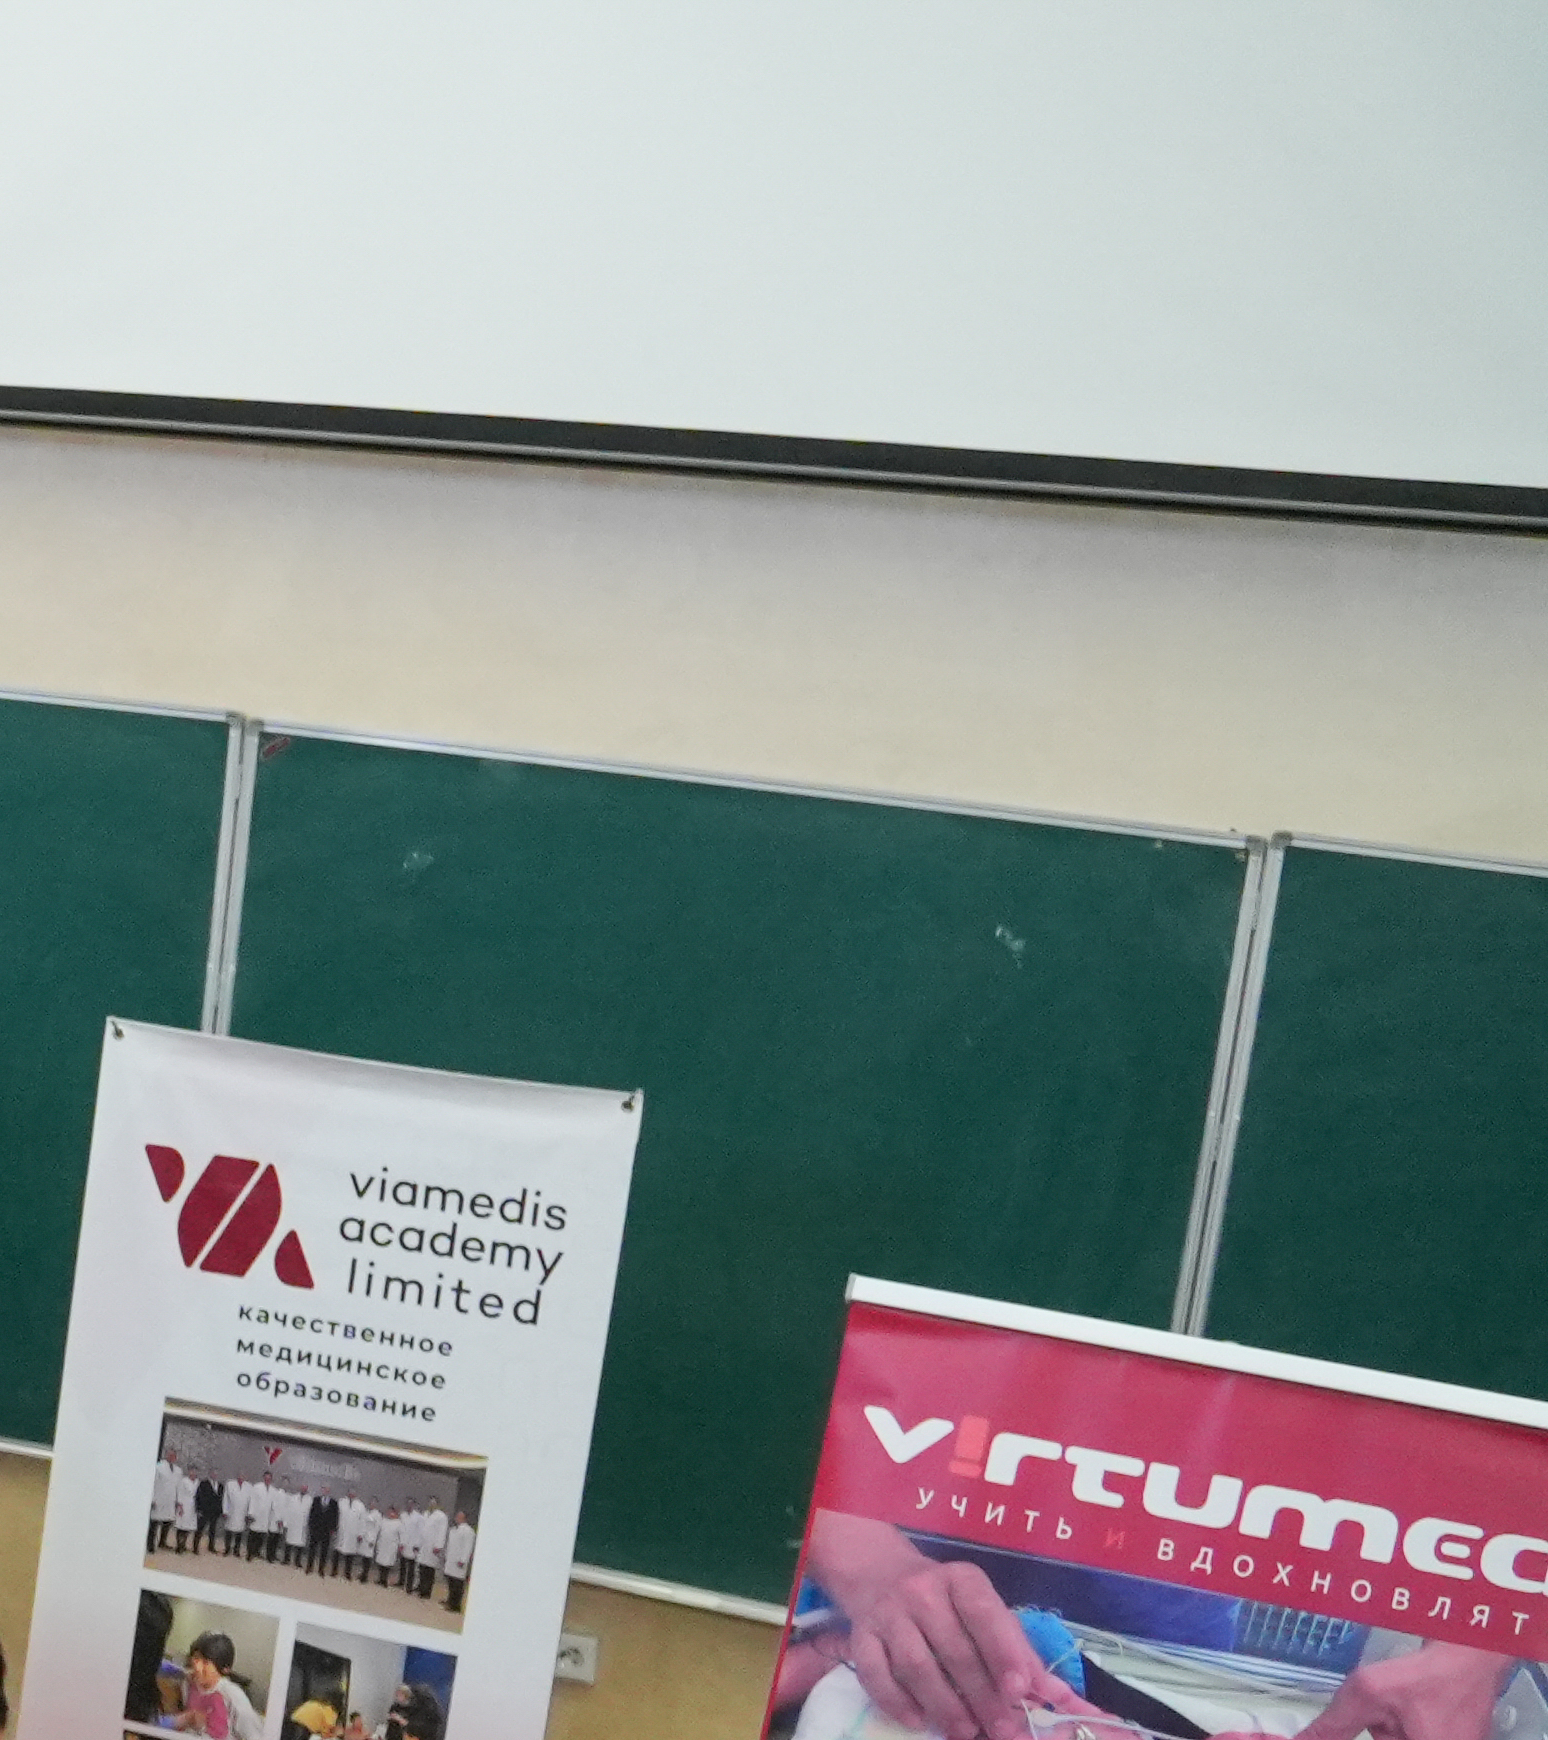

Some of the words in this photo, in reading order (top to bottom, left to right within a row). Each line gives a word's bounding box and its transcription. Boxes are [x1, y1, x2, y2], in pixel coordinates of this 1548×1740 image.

[349, 1166, 568, 1232] viamedis
[339, 1214, 564, 1284] academy
[347, 1258, 542, 1326] limited
[239, 1303, 454, 1358] качественное
[236, 1337, 446, 1390] медицинское
[236, 1368, 437, 1423] образование
[916, 1487, 1074, 1540] УЧИТЬ
